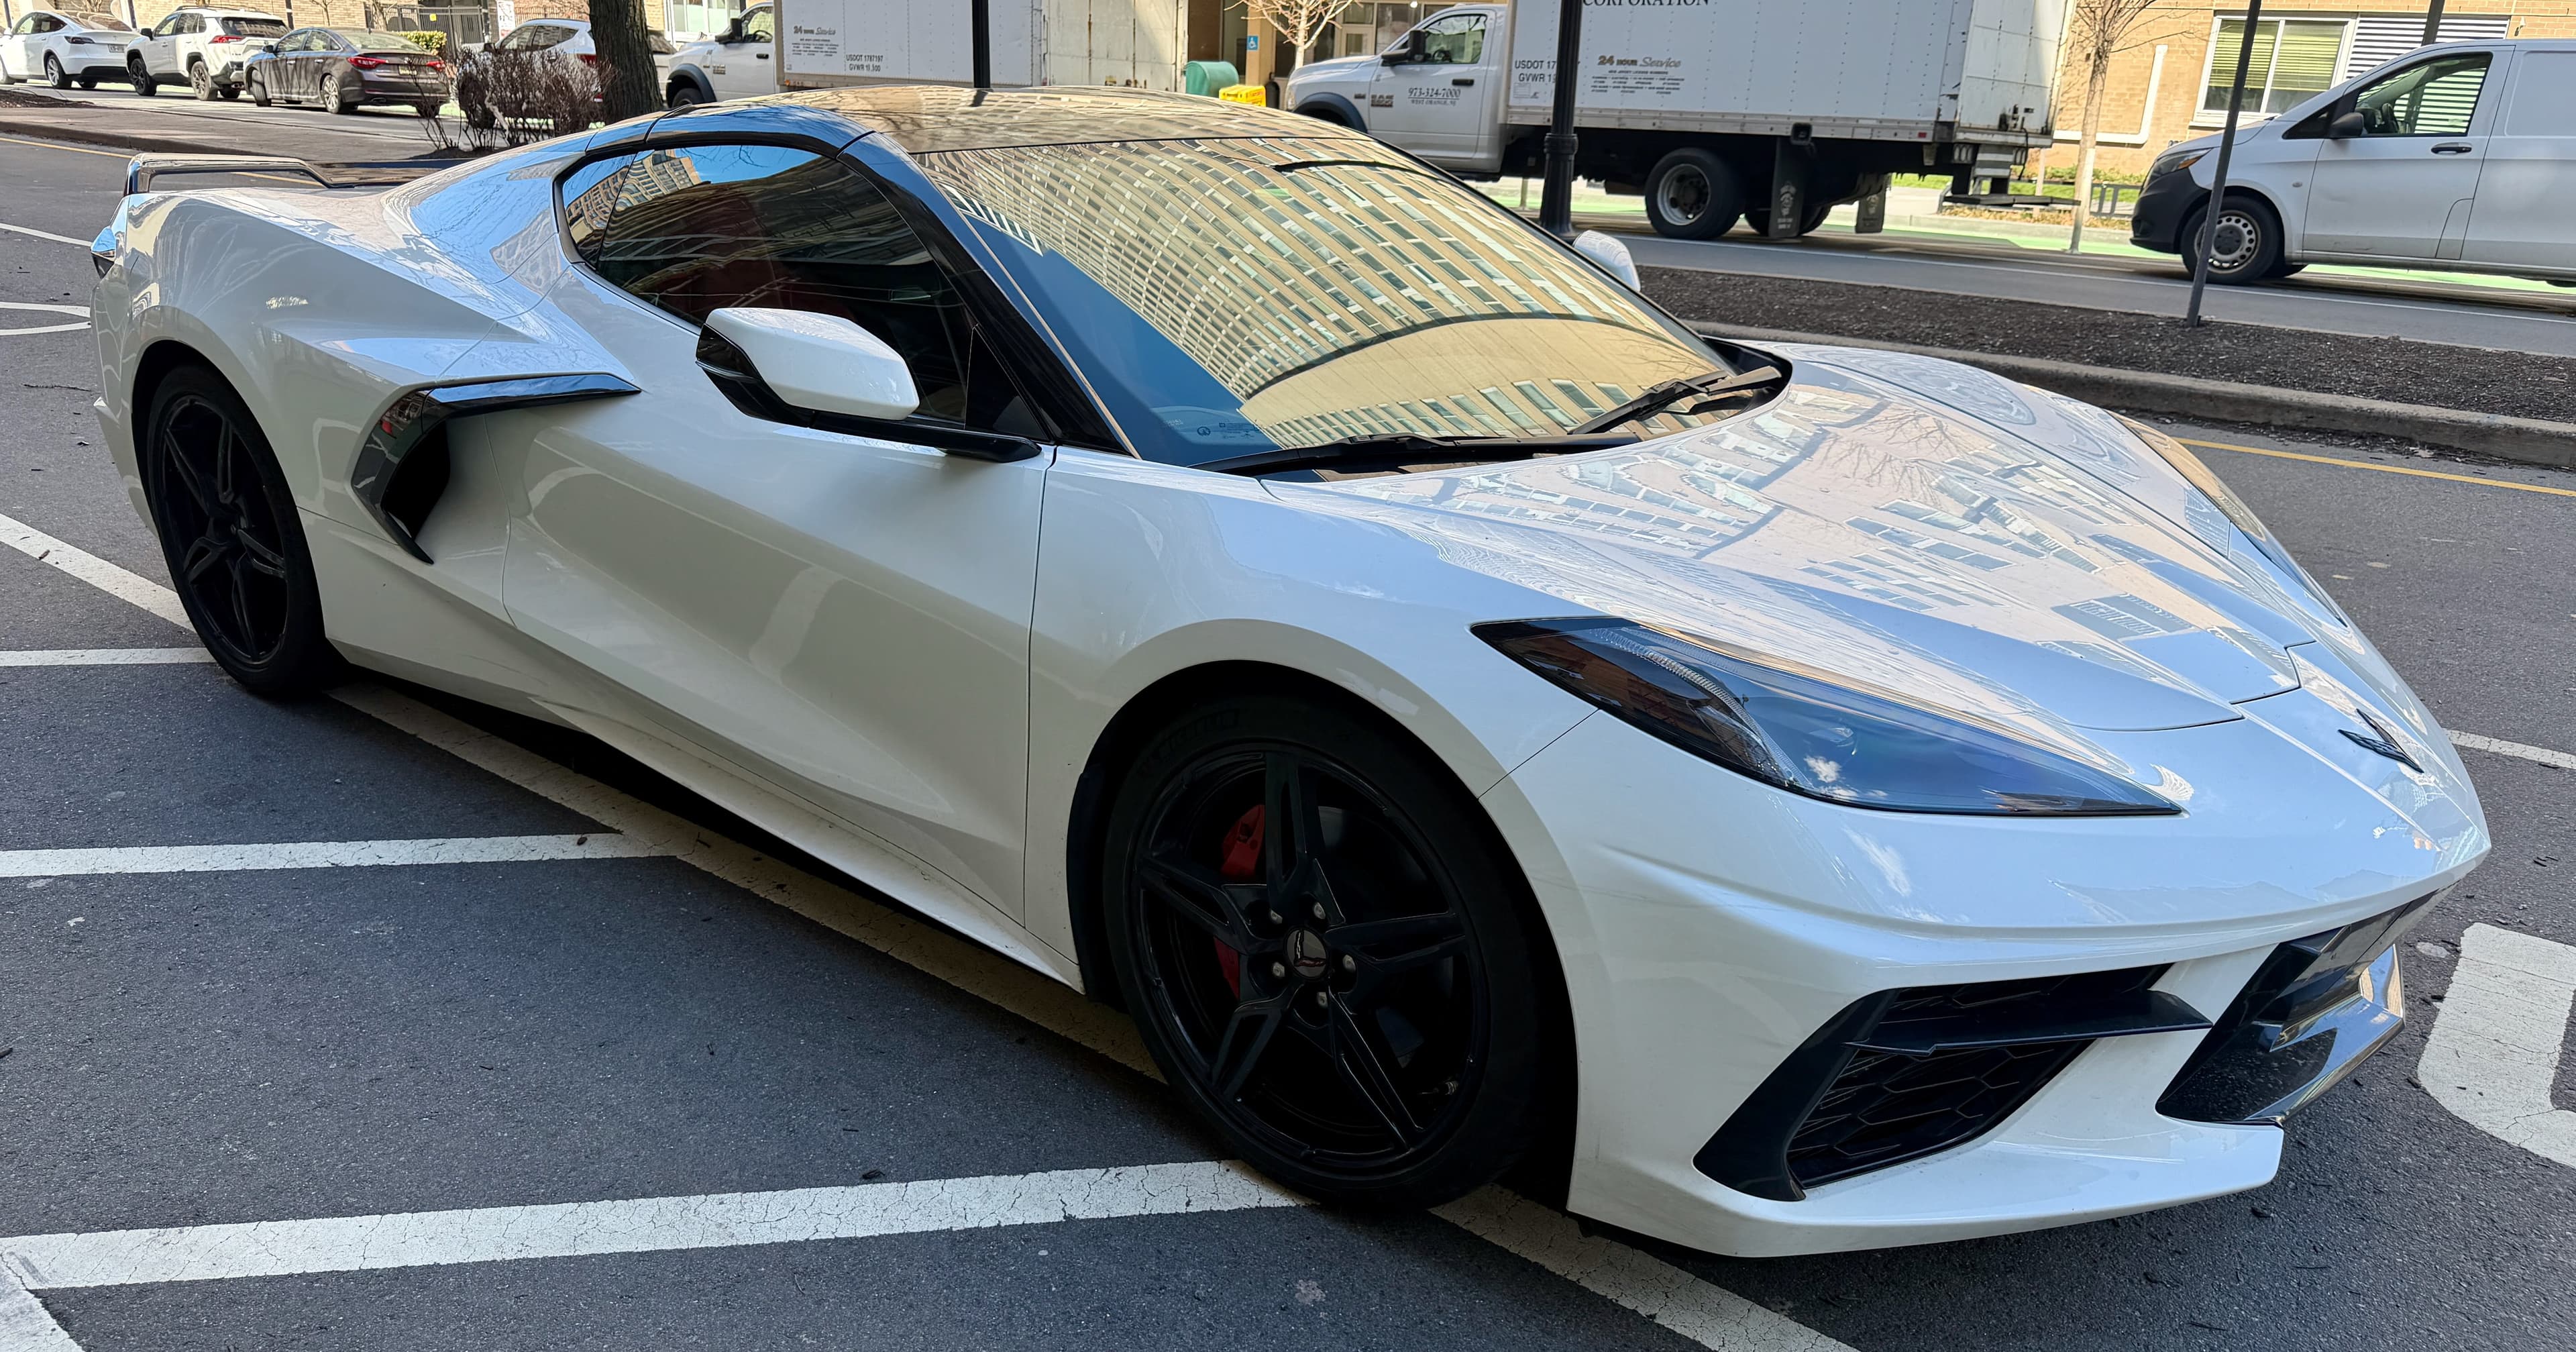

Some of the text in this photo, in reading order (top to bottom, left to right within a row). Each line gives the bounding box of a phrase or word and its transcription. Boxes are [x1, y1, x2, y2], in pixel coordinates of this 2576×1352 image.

[1515, 60, 1544, 69] USDOT
[1598, 55, 1614, 66] 24
[1639, 56, 1682, 69] Service
[1518, 72, 1546, 82] GVWR
[1408, 87, 1461, 98] 973-324-7000
